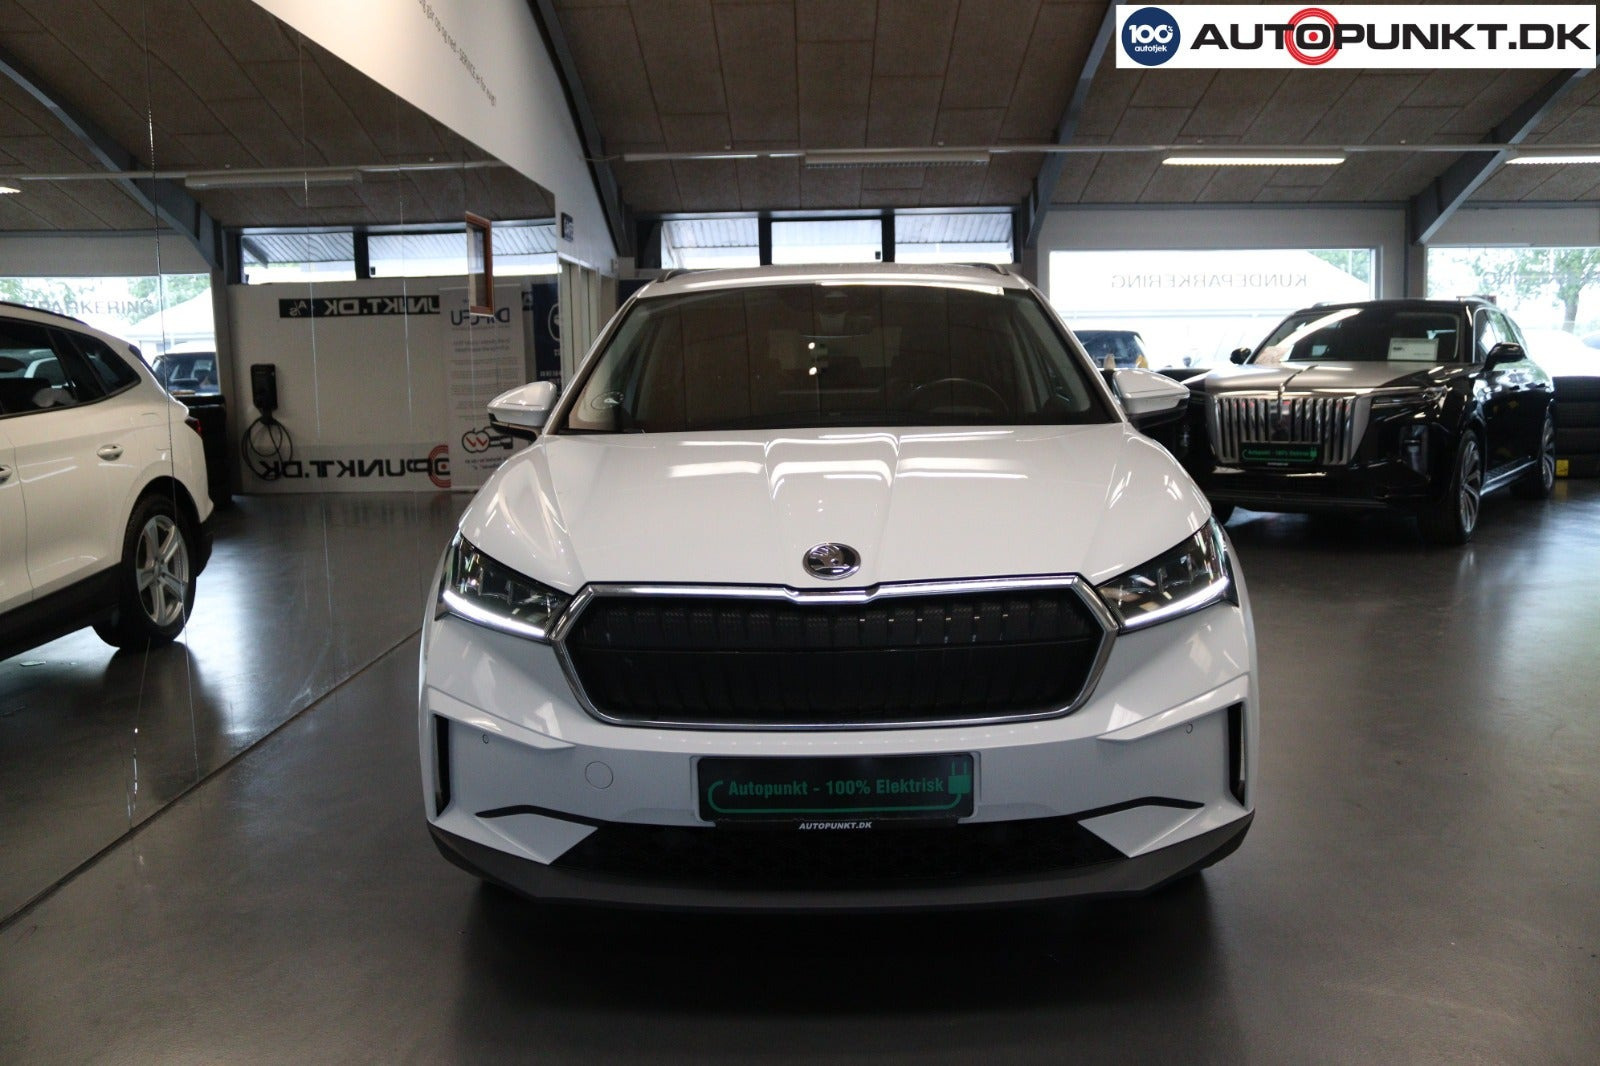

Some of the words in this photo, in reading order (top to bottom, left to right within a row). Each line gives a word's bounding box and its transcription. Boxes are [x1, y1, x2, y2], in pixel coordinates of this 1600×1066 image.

[728, 780, 808, 797] Autopunkt
[826, 779, 871, 795] 100%
[876, 777, 944, 794] Elektrisk
[798, 821, 872, 830] AUTOPUNKT.DK
